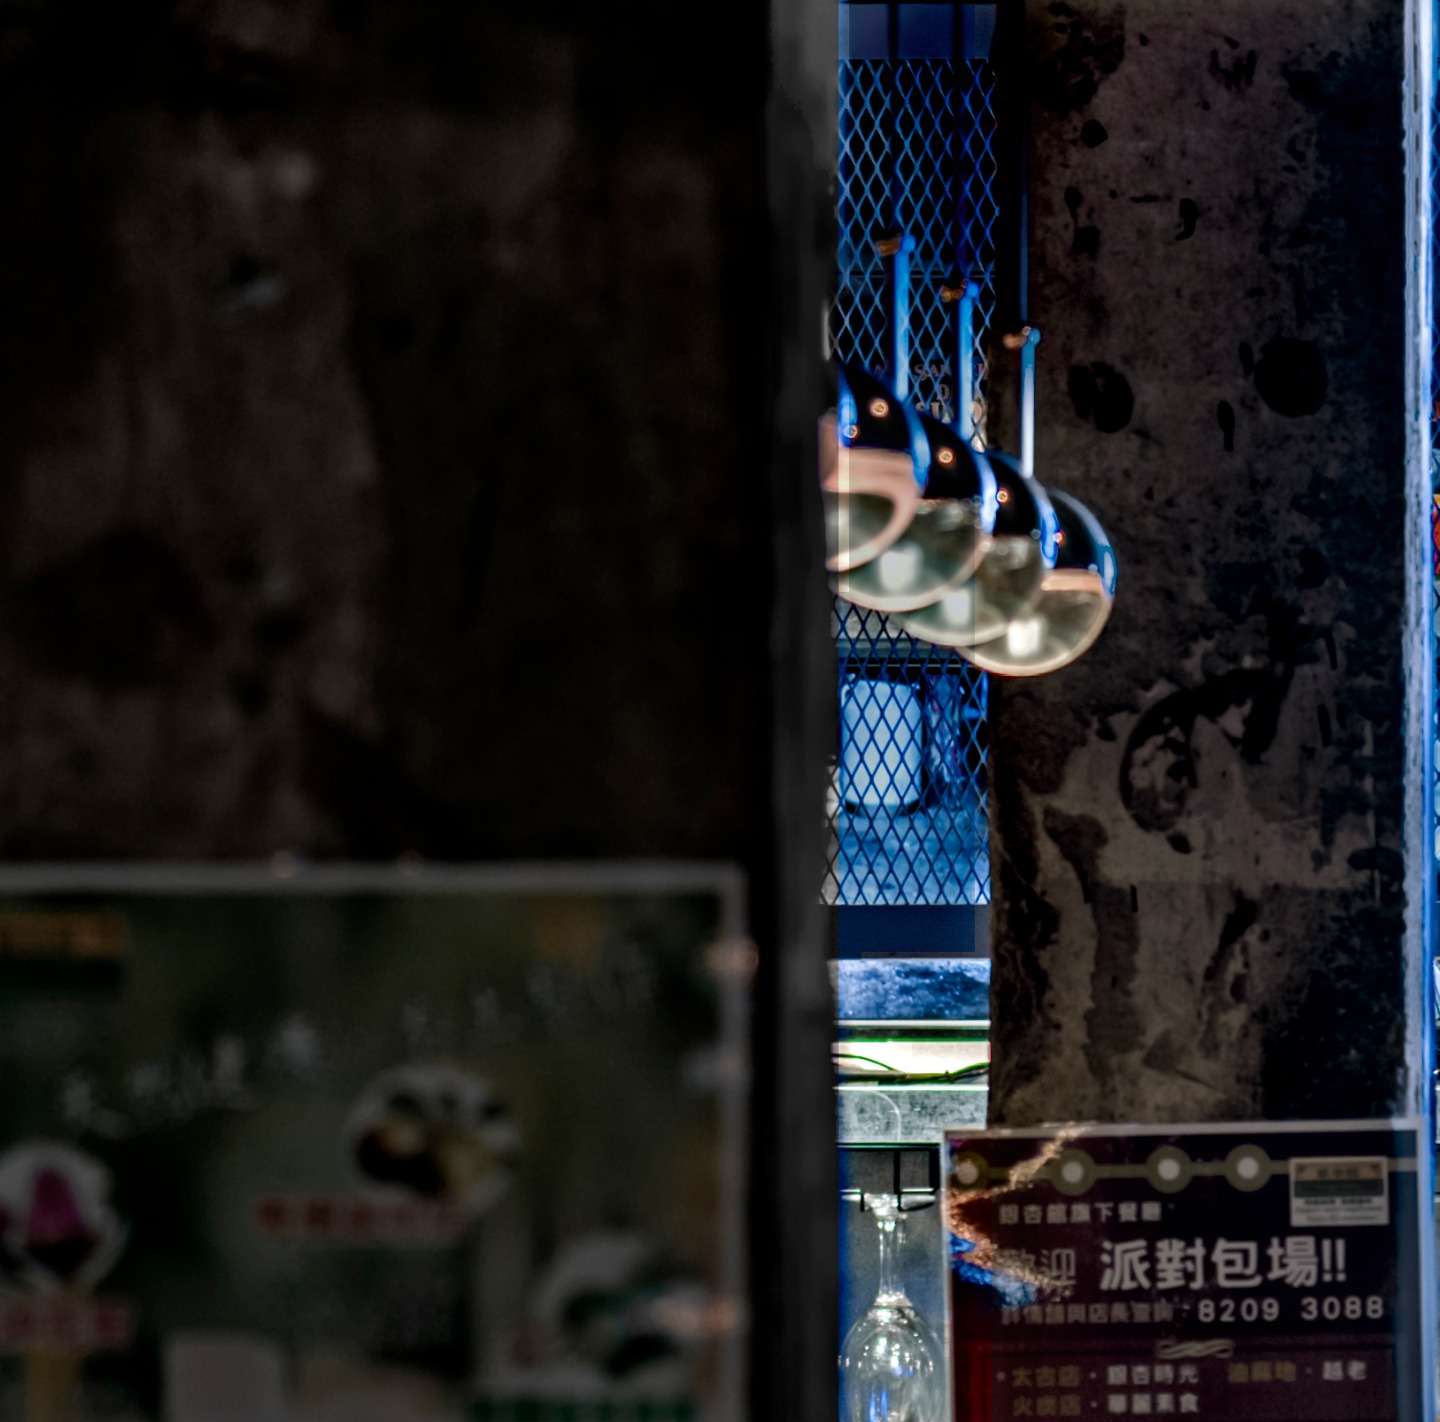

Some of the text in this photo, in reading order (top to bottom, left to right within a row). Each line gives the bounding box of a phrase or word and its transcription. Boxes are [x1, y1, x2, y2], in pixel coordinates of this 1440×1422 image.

[1098, 1235, 1347, 1291] 派對包場!!
[1197, 1297, 1281, 1323] 8209
[1300, 1295, 1385, 1321] 3088
